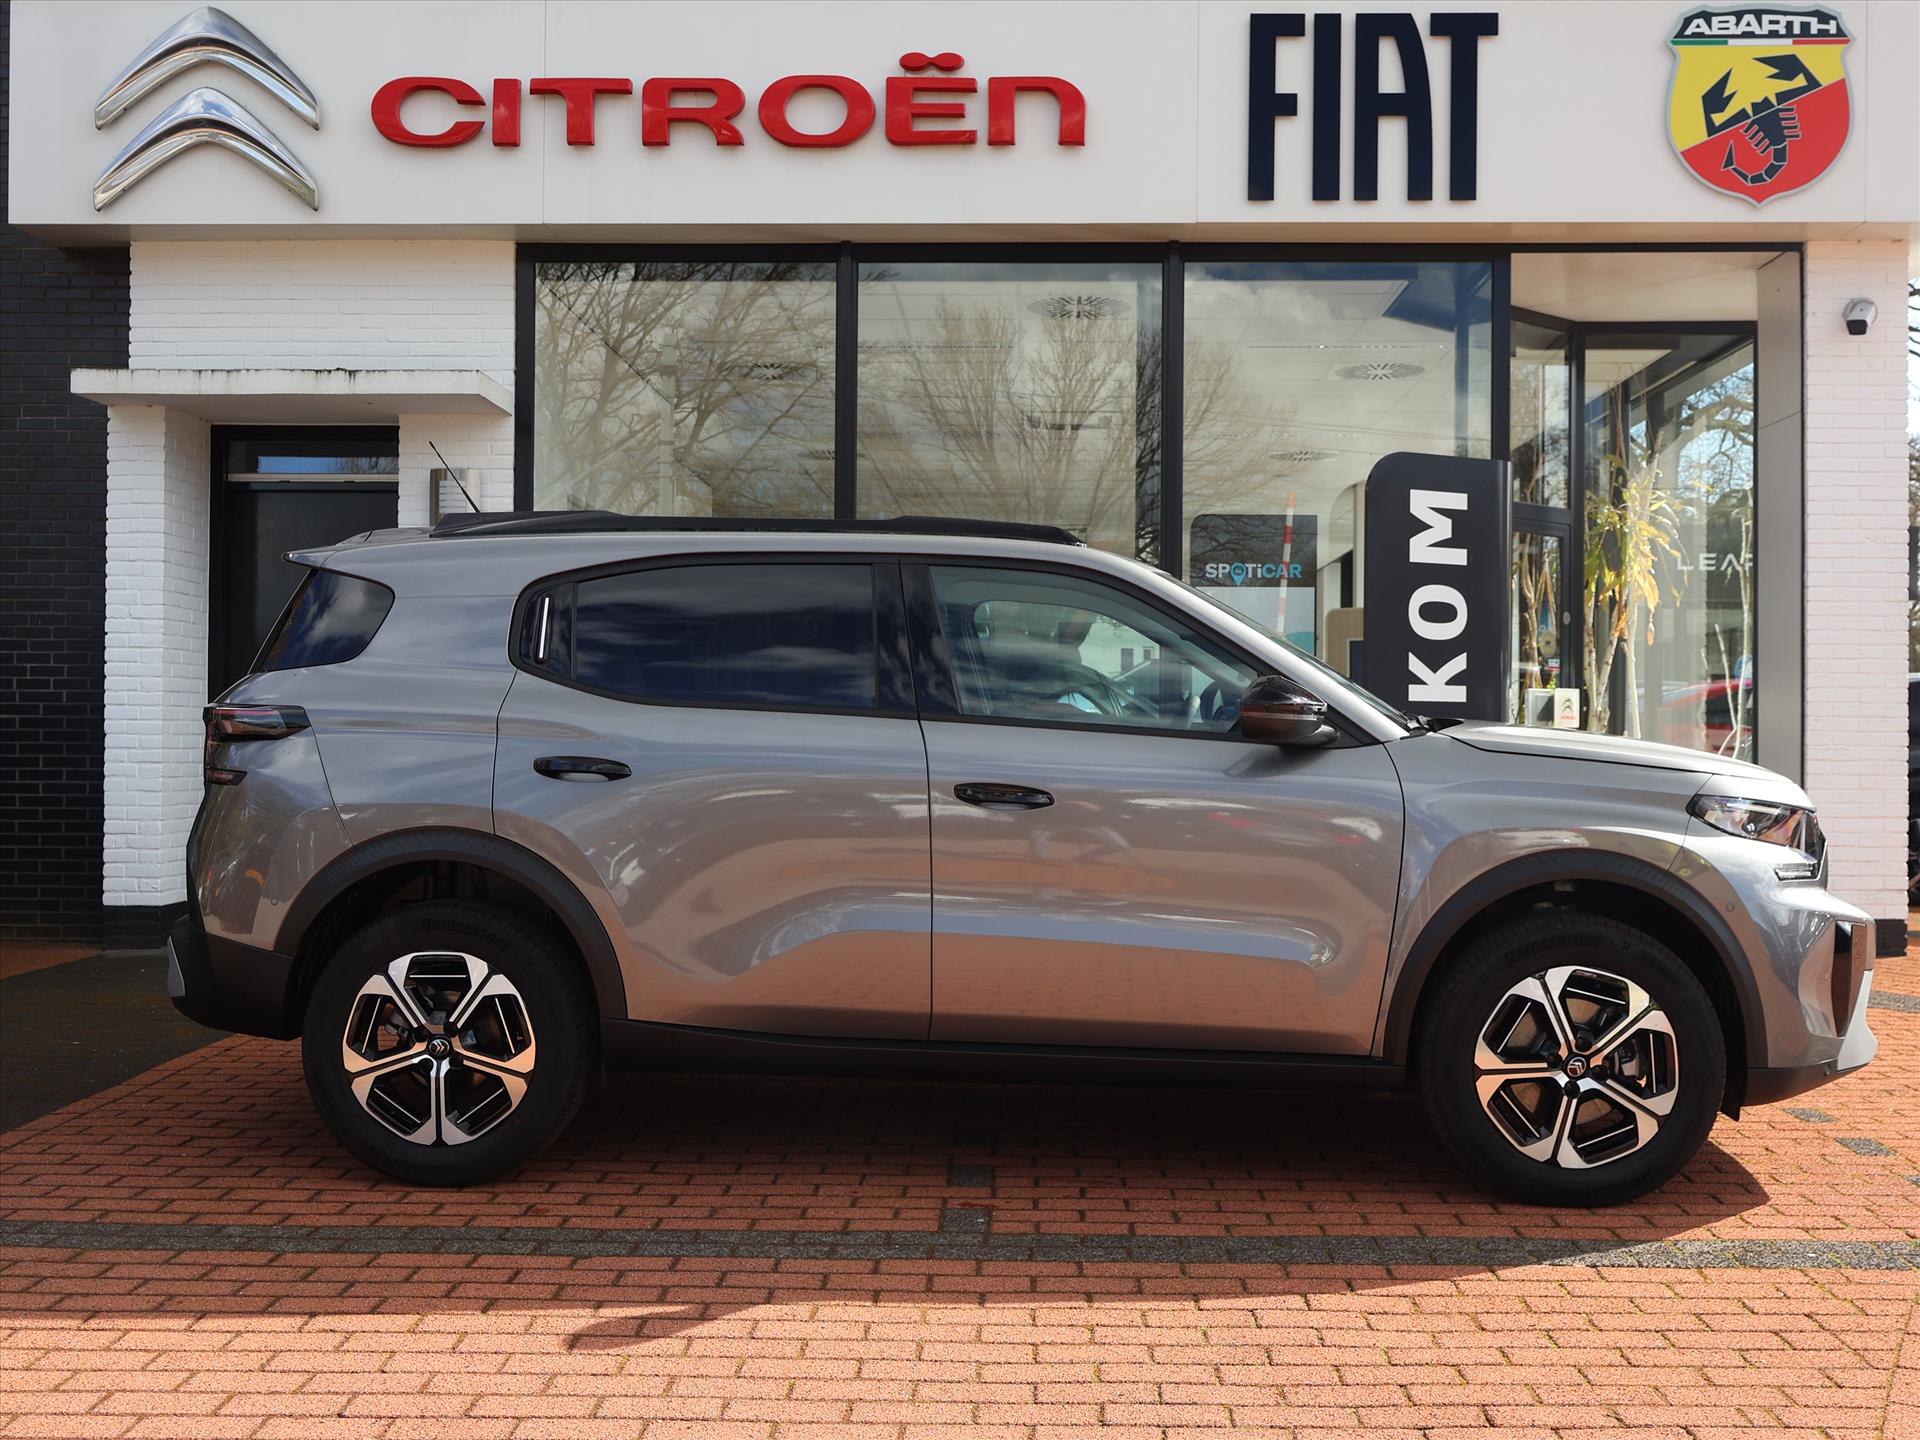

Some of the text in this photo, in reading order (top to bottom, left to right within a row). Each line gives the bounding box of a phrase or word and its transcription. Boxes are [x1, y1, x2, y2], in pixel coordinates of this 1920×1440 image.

[1684, 14, 1837, 35] ABARTH
[371, 52, 1086, 148] CITROËN
[1248, 13, 1498, 200] FIAT
[1408, 489, 1468, 702] KOM
